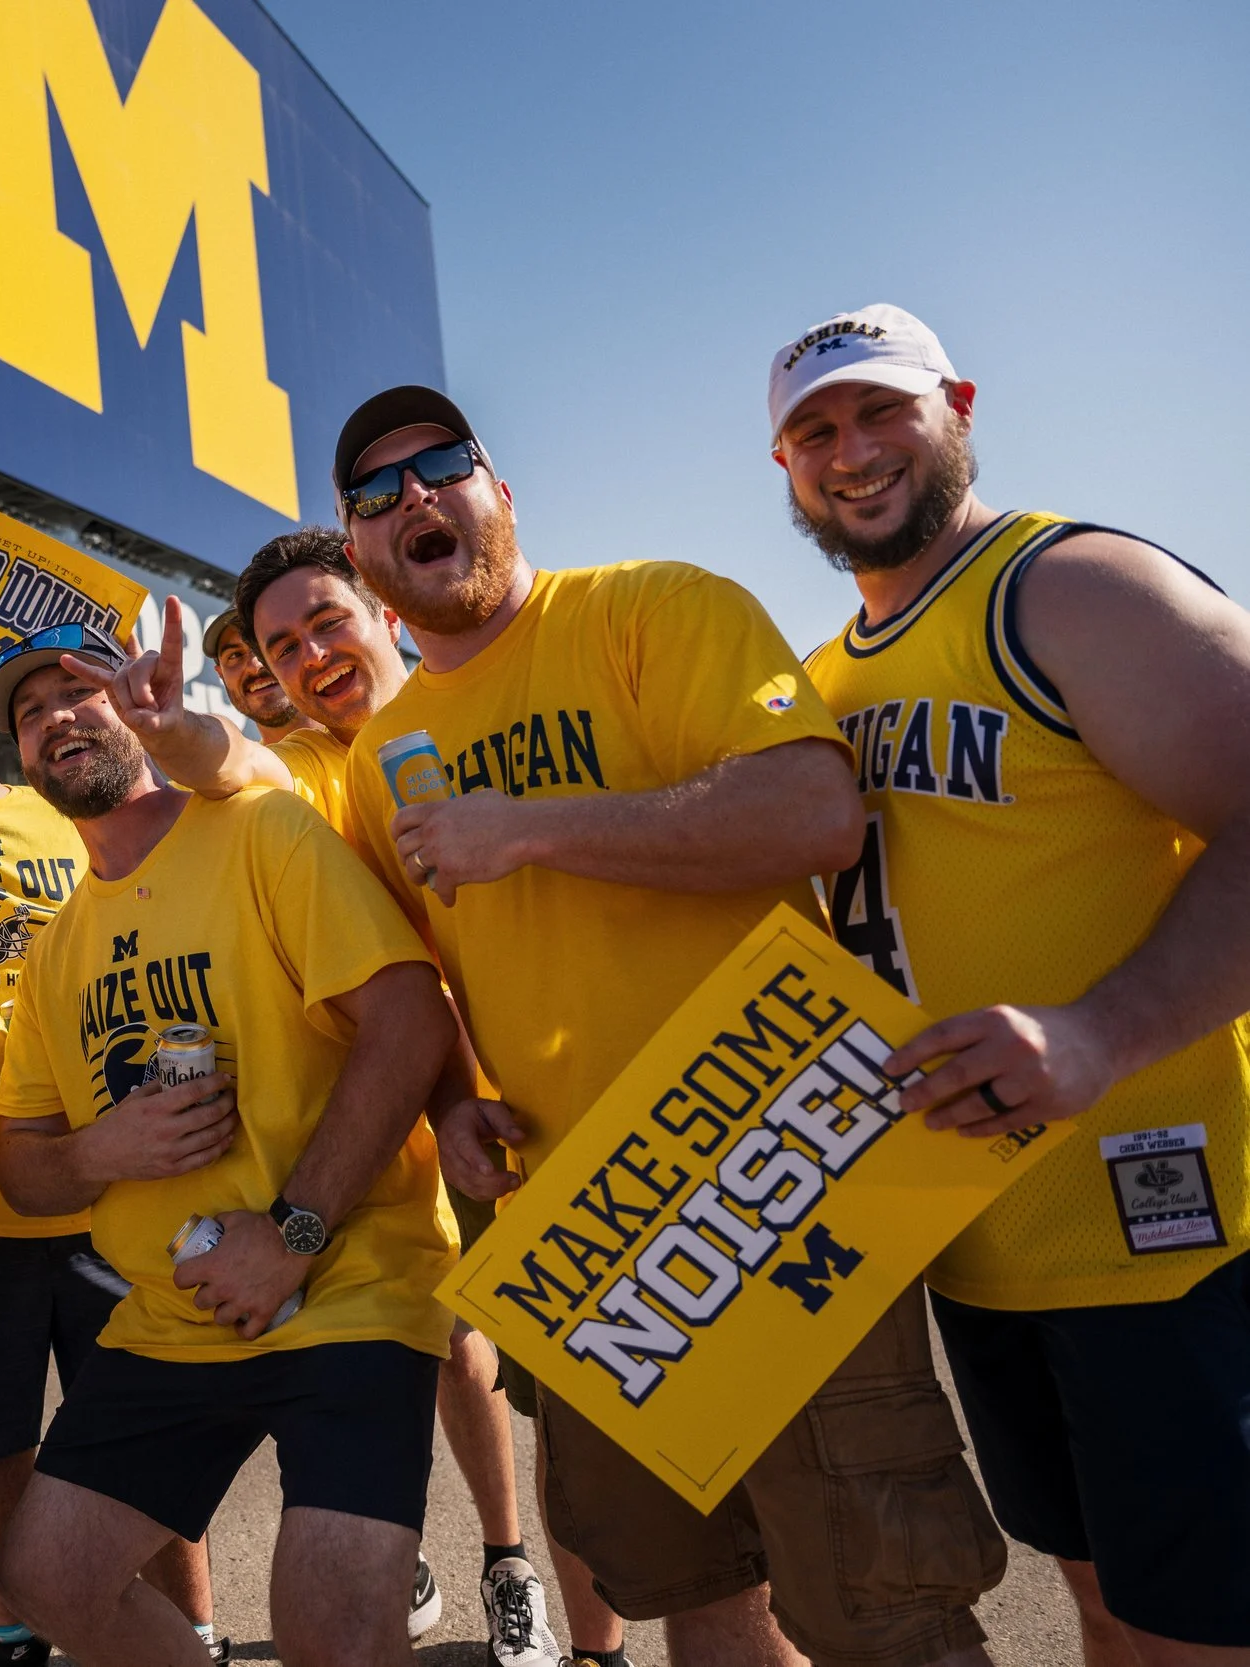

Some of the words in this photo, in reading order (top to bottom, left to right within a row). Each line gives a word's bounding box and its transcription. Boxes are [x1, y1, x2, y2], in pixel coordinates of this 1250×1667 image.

[783, 321, 887, 372] MICHIGAN
[816, 338, 846, 356] M
[447, 709, 606, 797] HIGAN
[406, 767, 440, 785] HIGH
[19, 857, 75, 901] OUT
[112, 929, 139, 962] M
[146, 951, 220, 1028] OUT
[493, 1131, 692, 1338] MAKE
[651, 963, 850, 1157] SOME
[1119, 1143, 1144, 1154] CHRIS
[1147, 1137, 1186, 1150] WEBBER
[563, 1017, 930, 1409] NOISE!!
[1131, 1197, 1171, 1210] College
[1170, 1192, 1199, 1205] Vault
[1136, 1225, 1175, 1244] Mitchell
[768, 1222, 868, 1315] M
